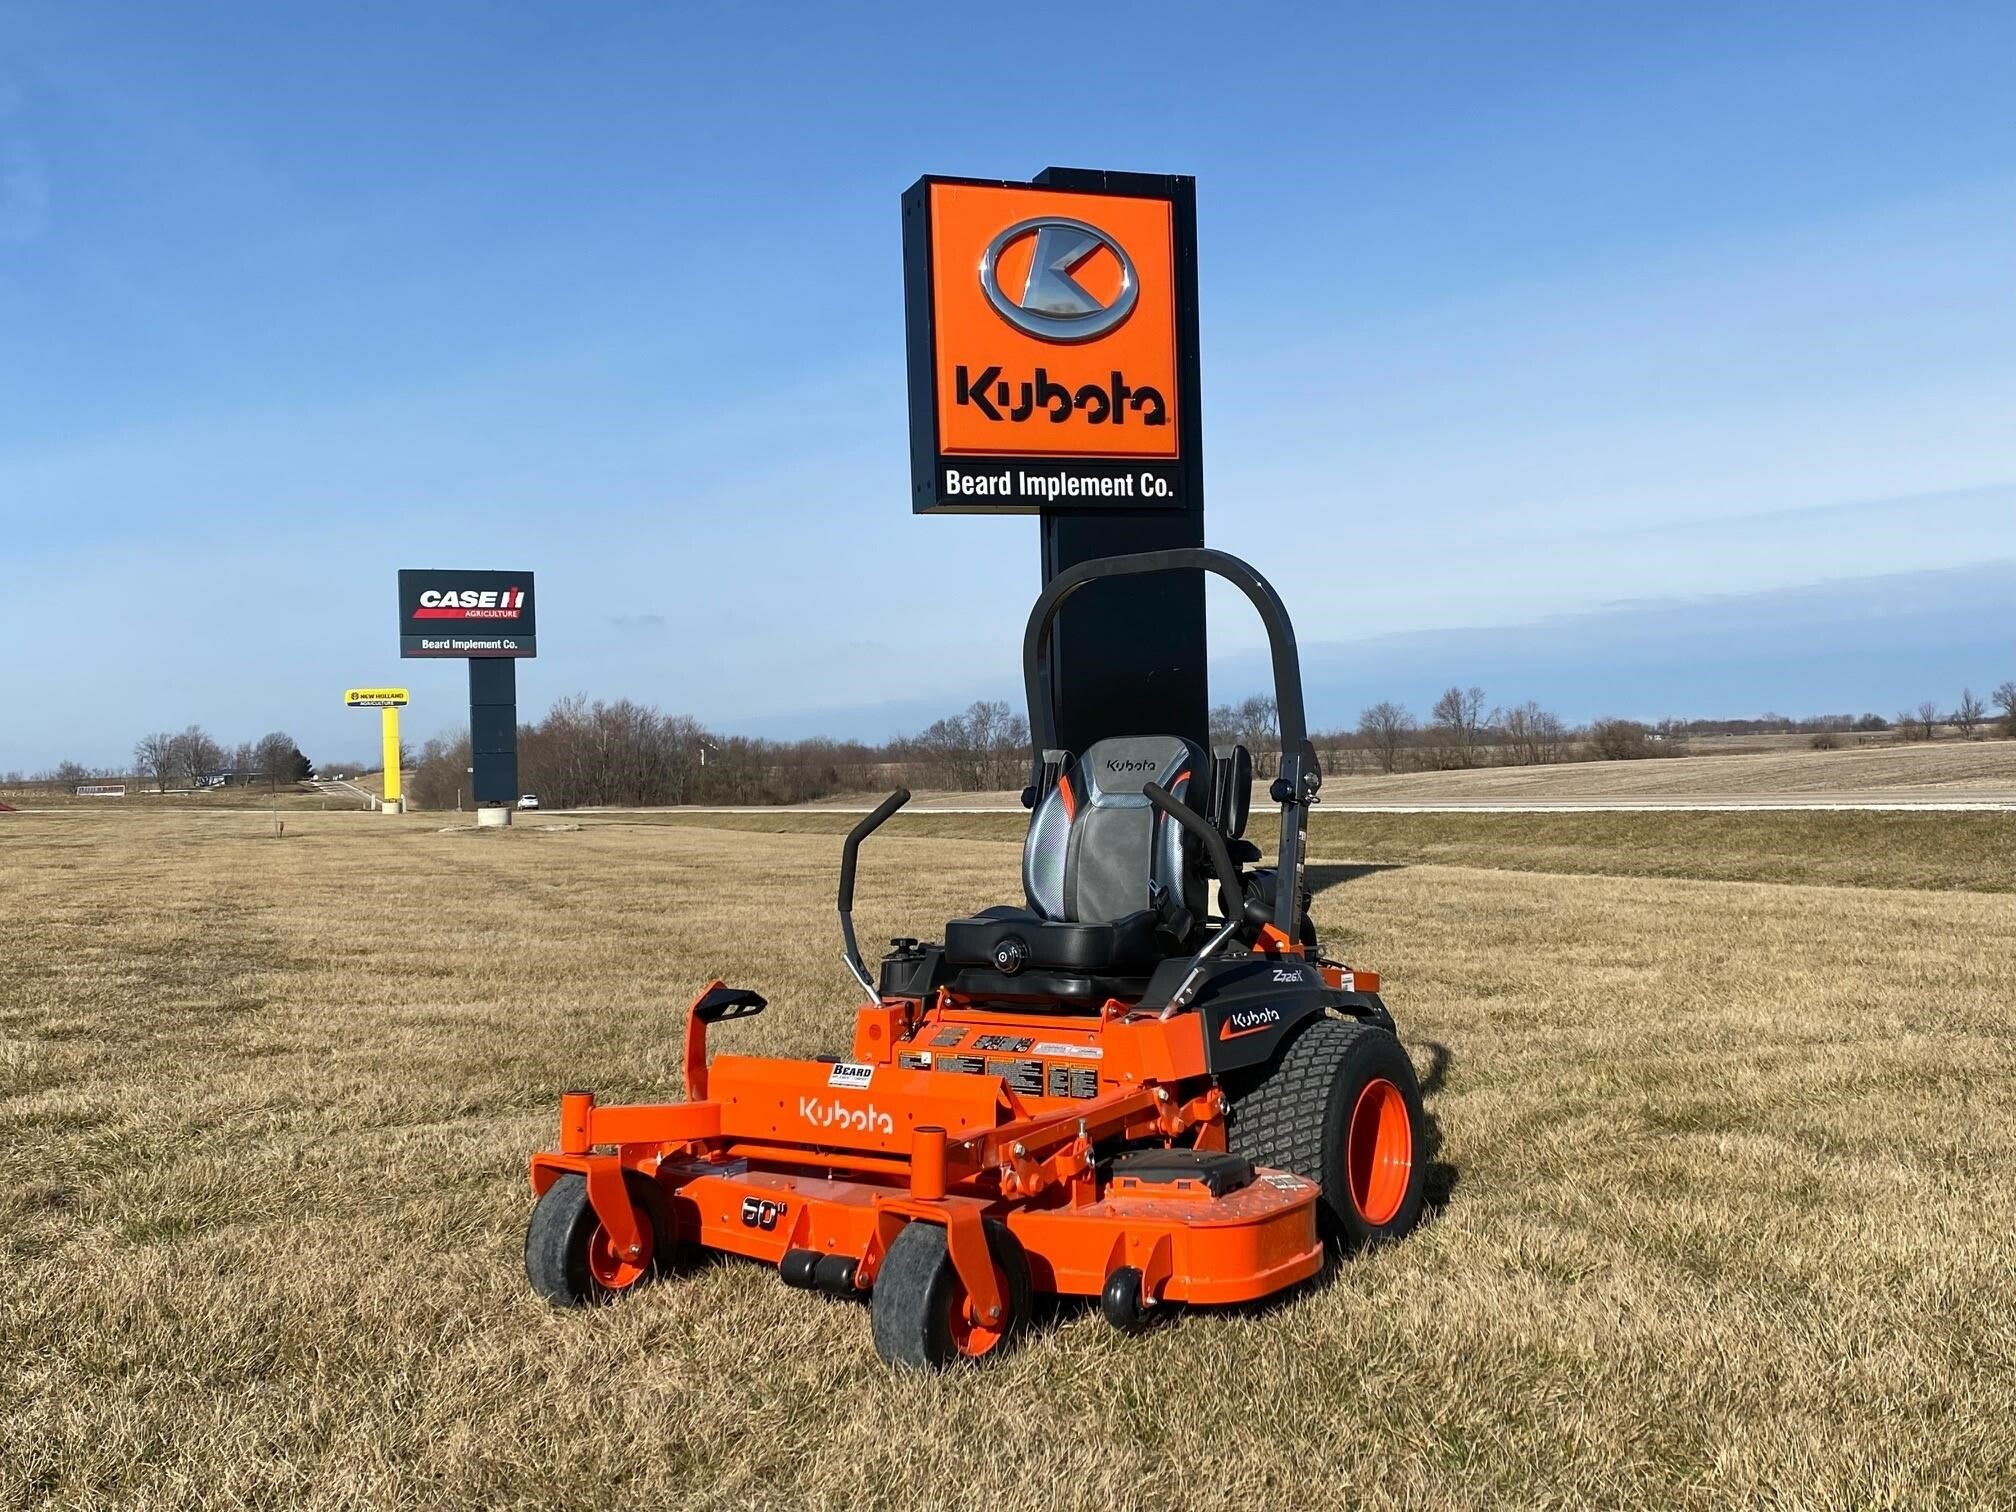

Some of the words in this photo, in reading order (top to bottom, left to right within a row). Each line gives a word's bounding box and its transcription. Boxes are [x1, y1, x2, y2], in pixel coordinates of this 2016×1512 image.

[955, 365, 1166, 426] Kubota
[946, 469, 1011, 496] Beard
[1019, 471, 1134, 501] Implement
[1140, 472, 1174, 498] Co.
[419, 590, 498, 608] CASE
[465, 609, 518, 618] AGRICULTURE
[422, 640, 450, 649] Beard
[452, 640, 501, 651] Implement
[503, 640, 518, 649] Co.
[1106, 759, 1156, 772] Kubota
[1272, 969, 1304, 983] Z726X
[1231, 1007, 1280, 1028] Kubota
[833, 1064, 872, 1078] BEARD
[799, 1096, 893, 1135] Kubota
